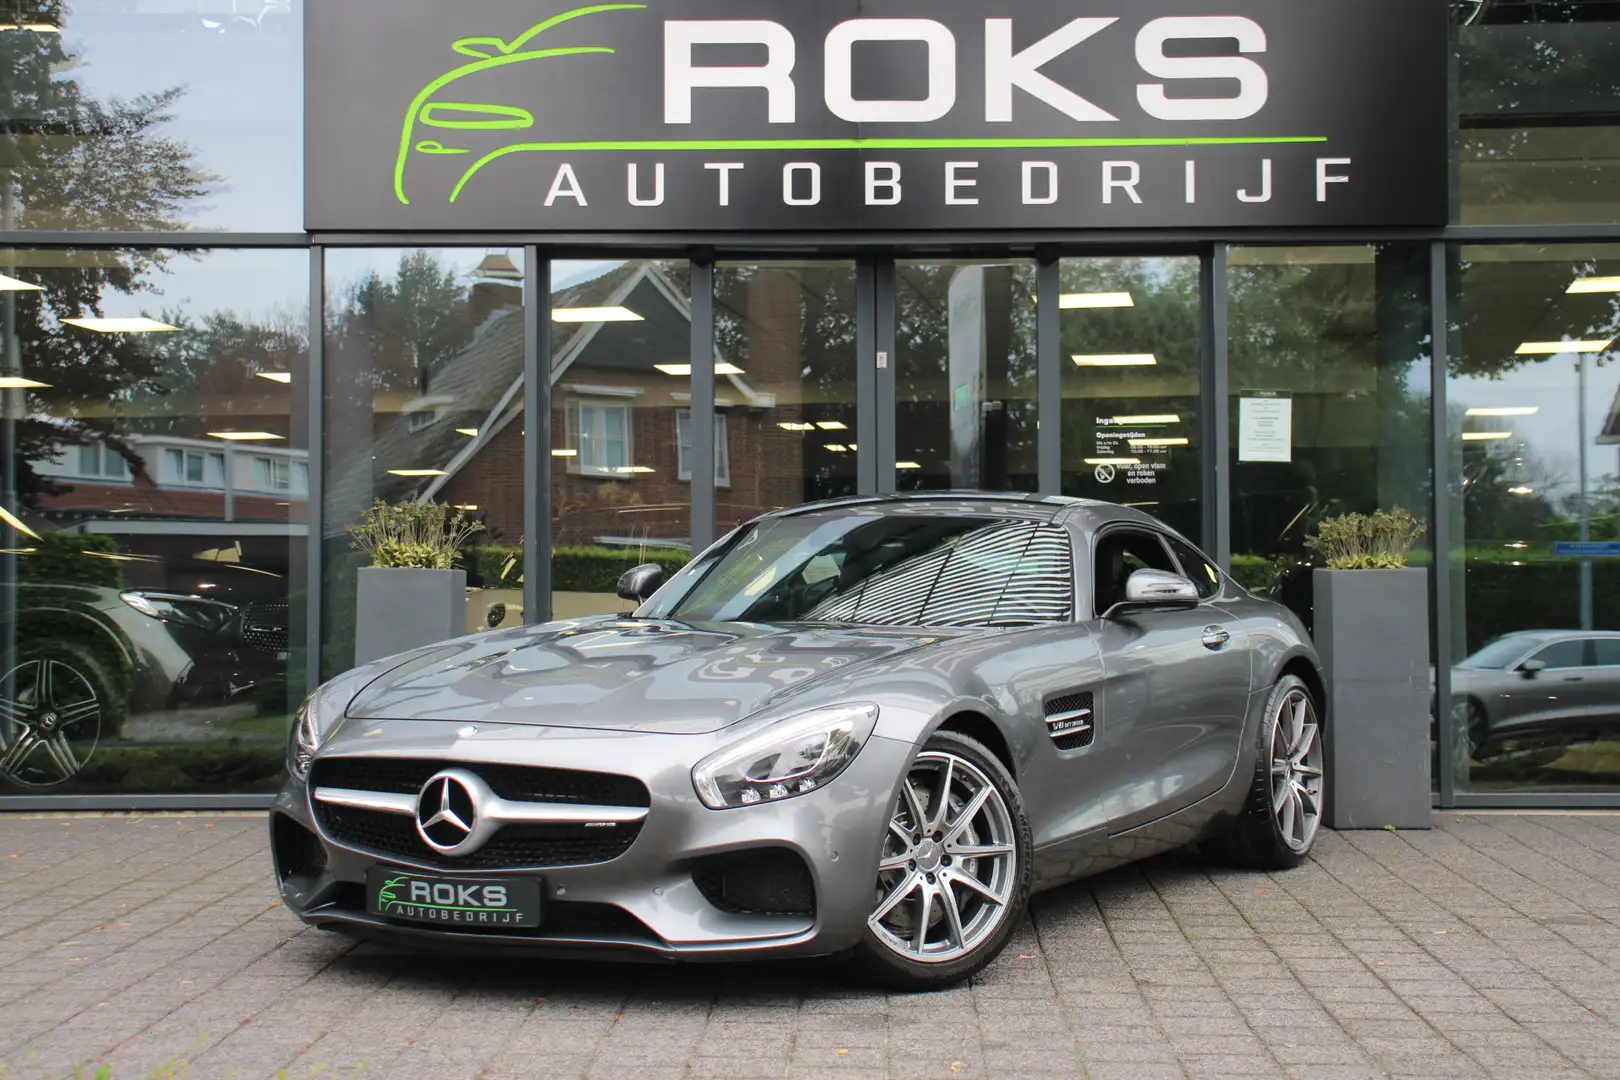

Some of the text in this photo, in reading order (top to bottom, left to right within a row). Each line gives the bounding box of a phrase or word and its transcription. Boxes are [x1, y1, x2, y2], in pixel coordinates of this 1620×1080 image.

[663, 15, 1269, 125] ROKS
[543, 157, 1352, 208] AUTOBEDRIJF
[410, 881, 508, 907] ROKS
[396, 905, 523, 923] AUTOBEDRIJF
